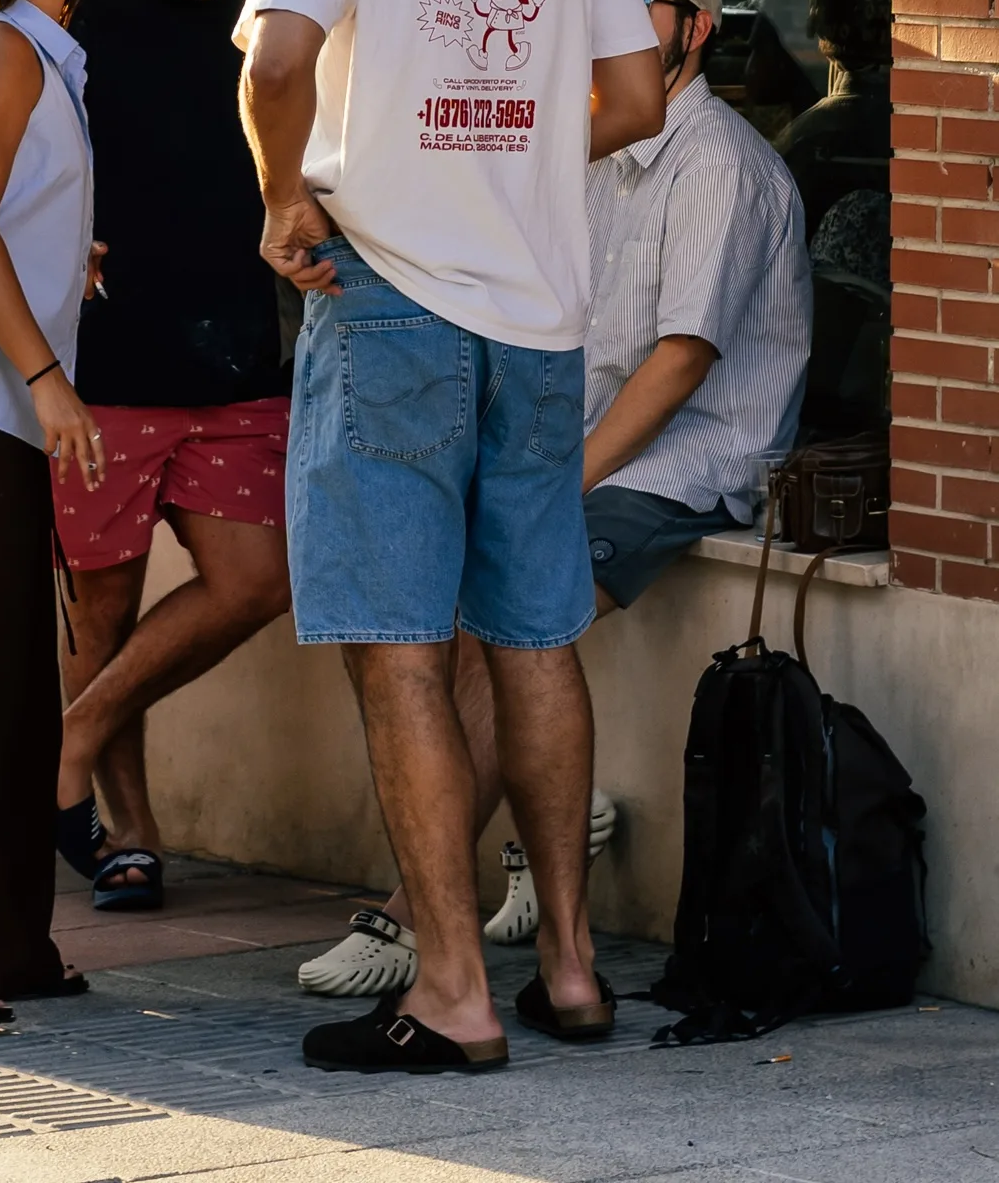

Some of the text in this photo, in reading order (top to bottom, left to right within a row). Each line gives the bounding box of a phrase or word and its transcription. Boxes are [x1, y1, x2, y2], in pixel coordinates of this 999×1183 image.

[436, 10, 461, 23] RING
[434, 17, 460, 30] RING
[419, 133, 432, 142] C.
[435, 134, 453, 142] DE
[456, 134, 472, 142] LA
[473, 134, 516, 143] LIBERTAD
[476, 143, 503, 152] 28004
[506, 143, 528, 153] (ES)
